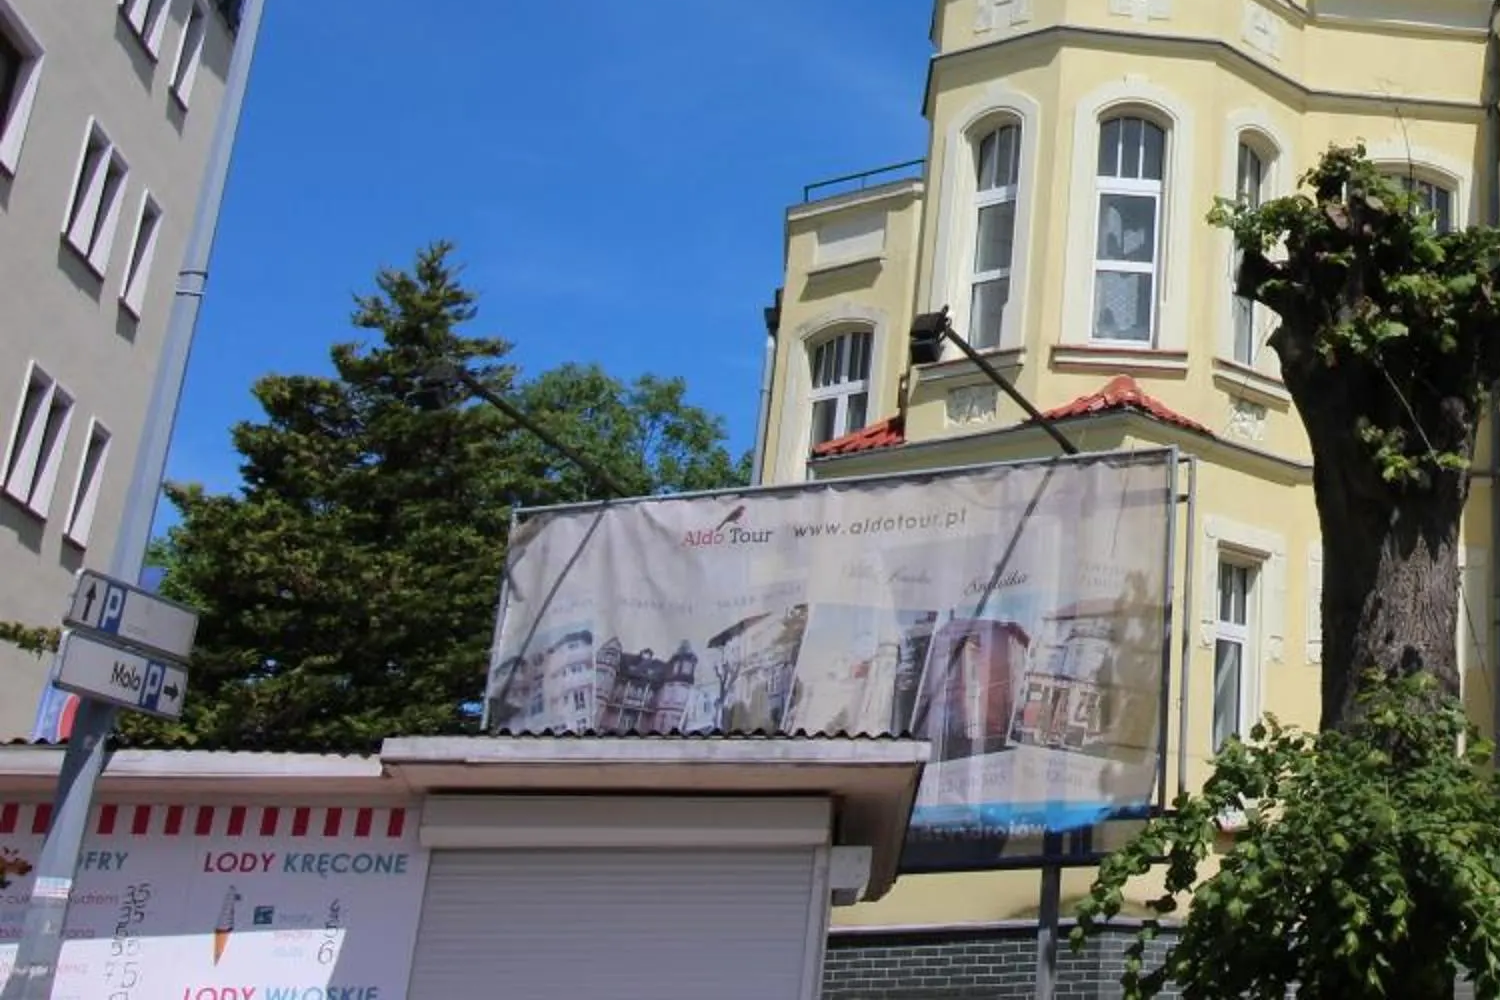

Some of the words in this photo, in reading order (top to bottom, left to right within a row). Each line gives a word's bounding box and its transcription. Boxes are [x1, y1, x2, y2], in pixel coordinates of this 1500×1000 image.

[793, 506, 967, 538] www.aldotour.pl
[681, 530, 724, 548] Aldo
[728, 528, 774, 544] Tour
[101, 586, 124, 629] P
[110, 660, 141, 692] Molo
[142, 662, 163, 707] P
[203, 852, 276, 873] LODY
[283, 852, 409, 879] KRĘCONE
[183, 986, 256, 1000] LODY
